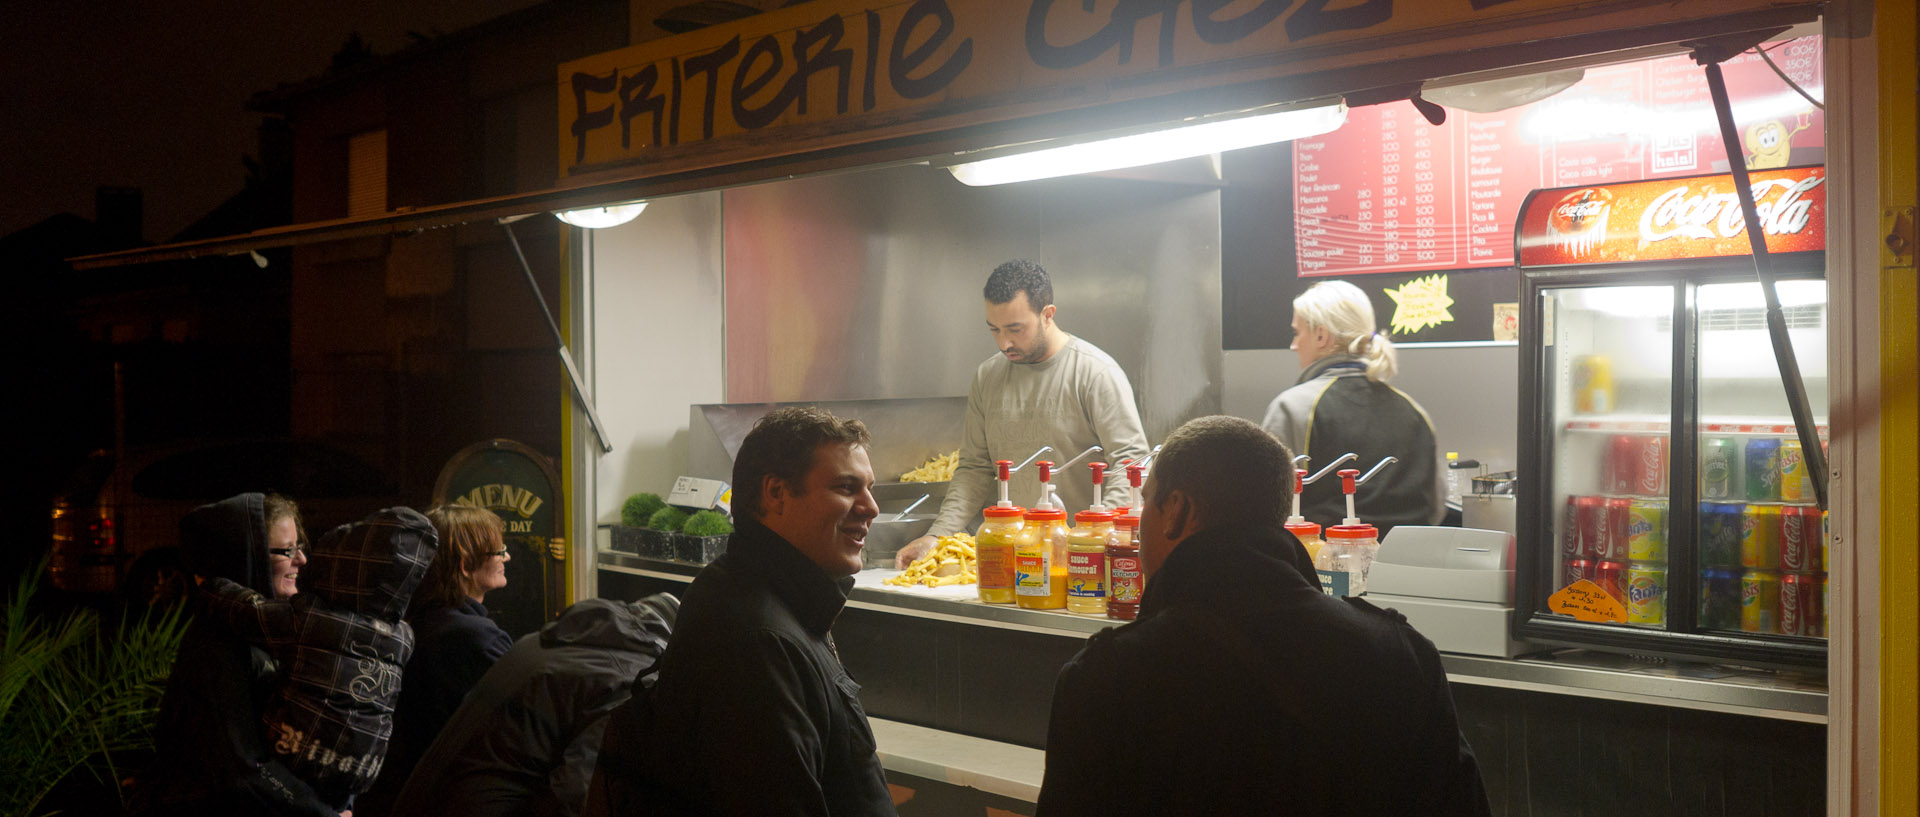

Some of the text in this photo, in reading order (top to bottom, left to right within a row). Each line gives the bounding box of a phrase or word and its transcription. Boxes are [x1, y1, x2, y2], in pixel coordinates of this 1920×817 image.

[1656, 150, 1693, 168] halal
[1416, 194, 1433, 204] 500
[1416, 205, 1433, 216] 500
[1417, 239, 1435, 249] 500
[1417, 250, 1436, 260] 500
[455, 483, 544, 518] MENU
[510, 521, 533, 533] DAY
[1783, 513, 1801, 569] Coca-Cola
[1780, 580, 1797, 635] Coca-Cola
